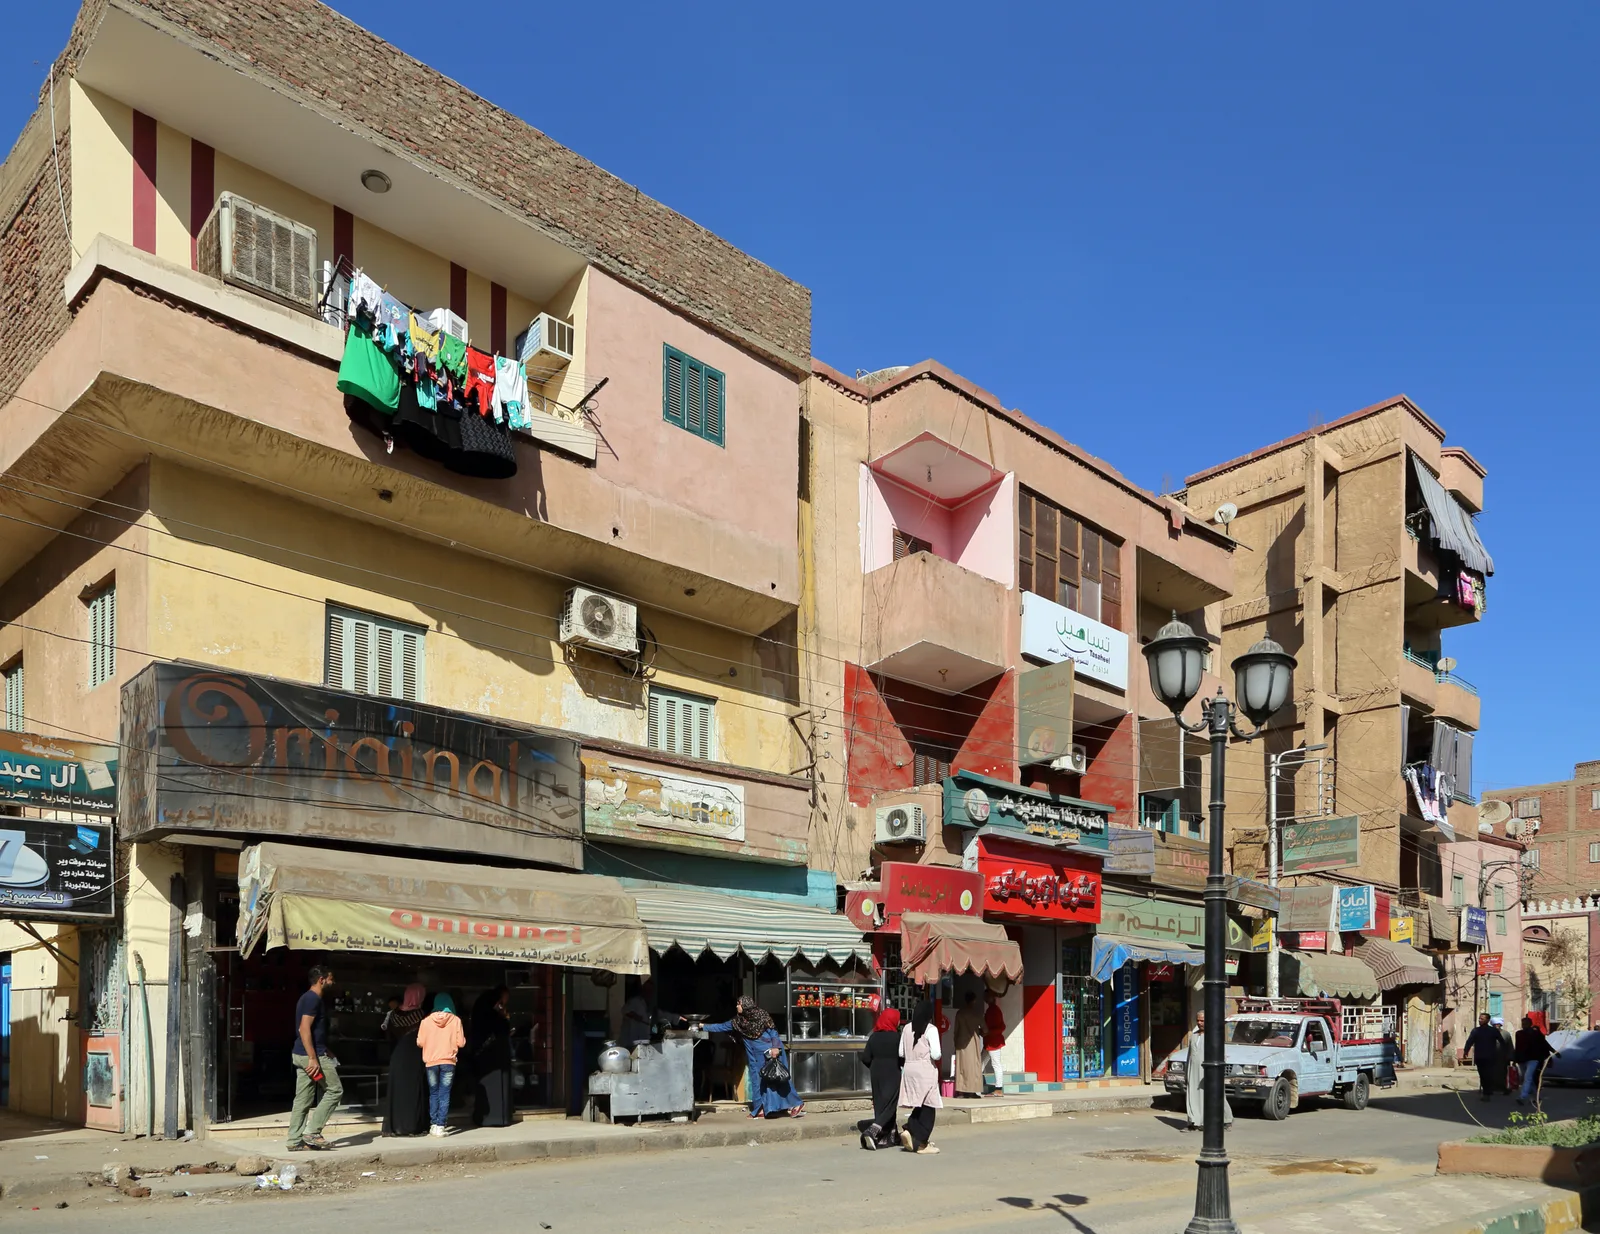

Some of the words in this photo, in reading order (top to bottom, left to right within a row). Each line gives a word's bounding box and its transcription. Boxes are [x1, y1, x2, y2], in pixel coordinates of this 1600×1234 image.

[1055, 616, 1110, 653] تساهيل
[1089, 649, 1111, 665] Tasaheel
[50, 763, 79, 788] آل
[40, 791, 71, 806] تجارية
[72, 797, 114, 810] مطبوعات
[68, 857, 86, 867] سوفت
[86, 858, 107, 869] صيانة
[71, 869, 85, 878] هارد
[85, 869, 105, 879] صيانة
[0, 889, 64, 905] للكمبيوتر
[1340, 887, 1369, 908] أمان
[312, 930, 339, 944] شراء
[345, 934, 365, 949] بيع
[371, 934, 415, 952] طابعات
[424, 939, 477, 956] اكسسوارات
[484, 944, 514, 960] صيانة
[520, 947, 552, 962] مراقبة
[554, 950, 587, 964] كاميرات
